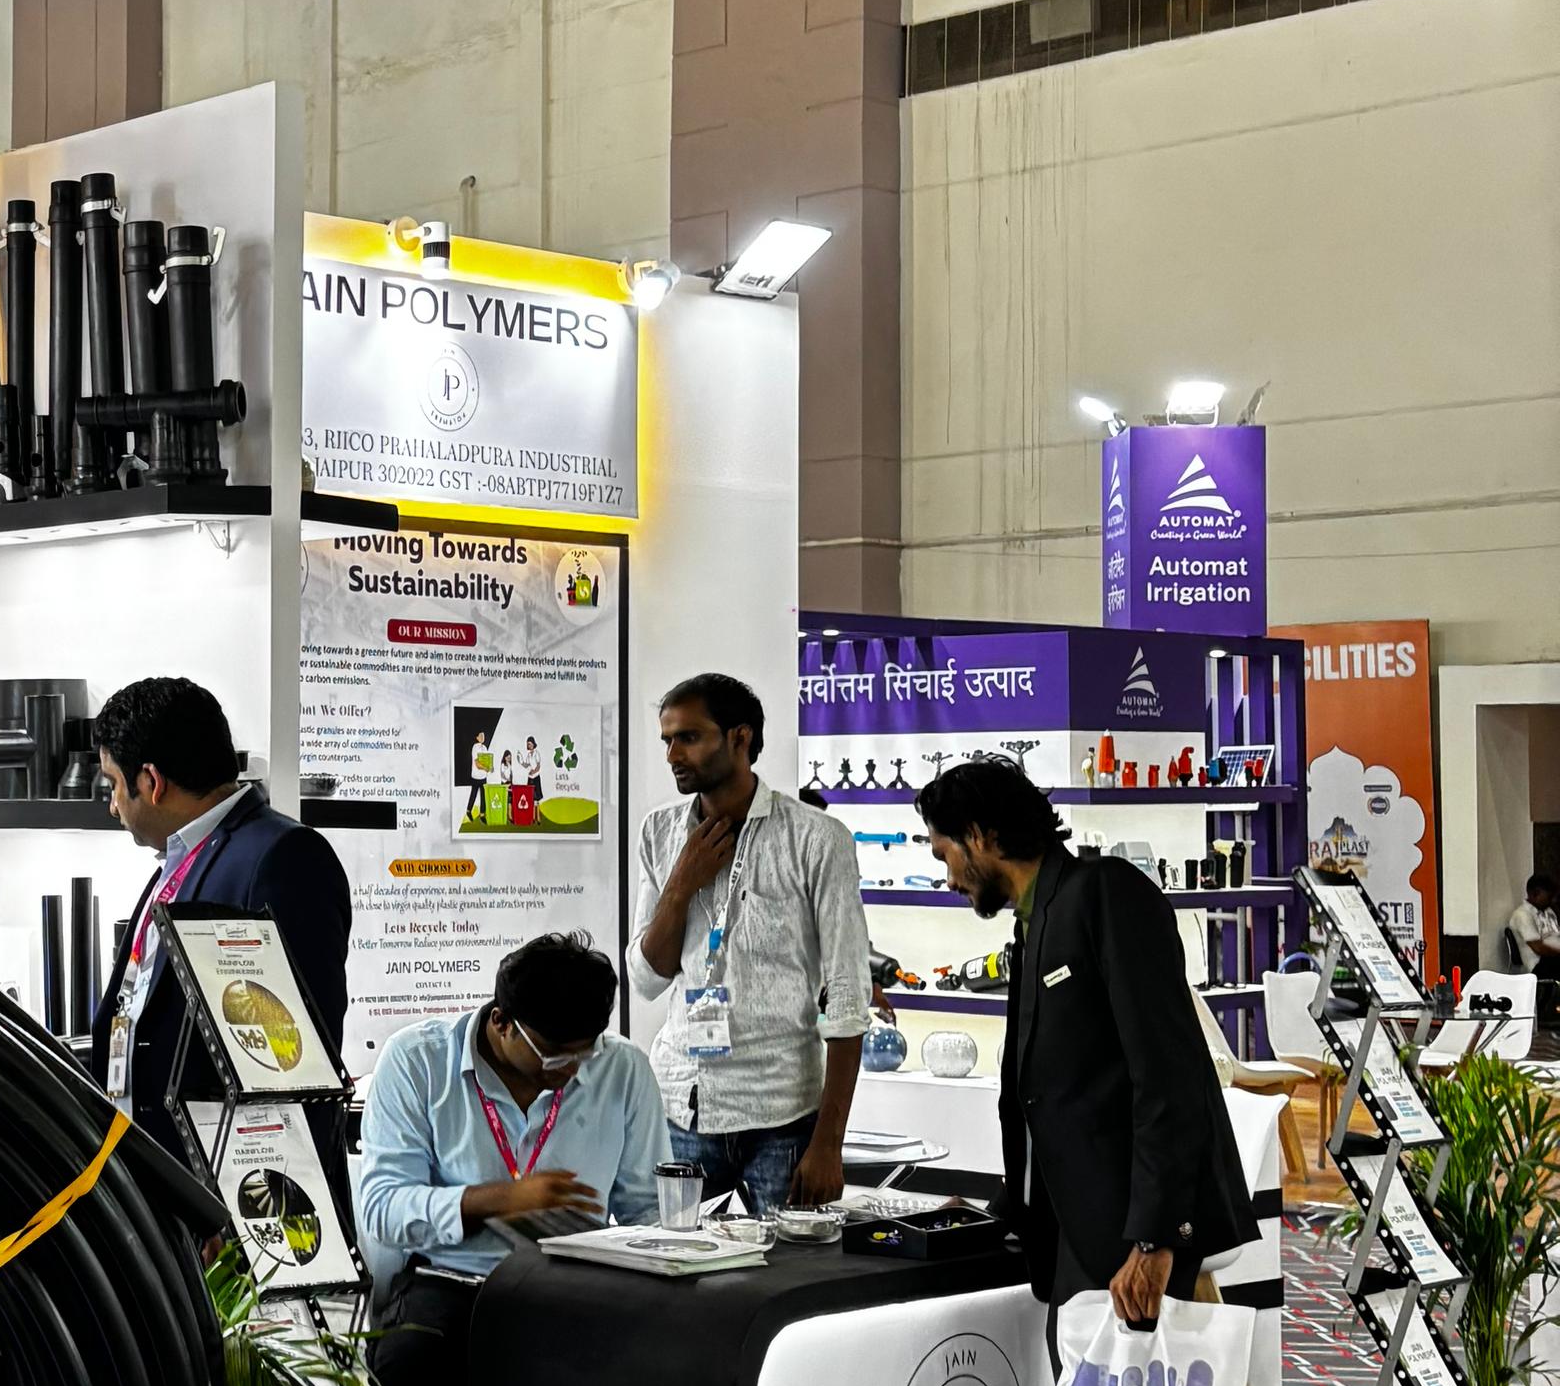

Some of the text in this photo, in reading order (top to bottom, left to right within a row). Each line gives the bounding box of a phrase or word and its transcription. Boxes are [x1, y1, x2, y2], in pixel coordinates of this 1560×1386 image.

[381, 280, 608, 350] POLYMERS
[324, 429, 618, 479] RIICO PRAHALADPURA INDUSTRIAL
[378, 464, 472, 492] 302022 GST
[1159, 516, 1234, 527] AUTOMAT
[428, 531, 527, 564] Towards
[1149, 556, 1248, 576] Automat
[348, 565, 514, 609] Sustainability
[1147, 582, 1251, 605] Irrigation
[398, 625, 466, 640] OUR MISSION
[323, 645, 353, 656] towards
[361, 647, 389, 658] greener
[390, 647, 413, 658] future
[415, 649, 428, 659] and
[445, 652, 453, 661] to
[454, 653, 476, 662] create
[484, 653, 503, 663] world
[505, 655, 526, 664] where
[579, 659, 607, 669] products
[797, 658, 1036, 705] सर्वोत्तम सिंचाई उत्पाद
[386, 960, 480, 974] JAIN POLYMERS
[945, 1349, 977, 1378] JAIN
